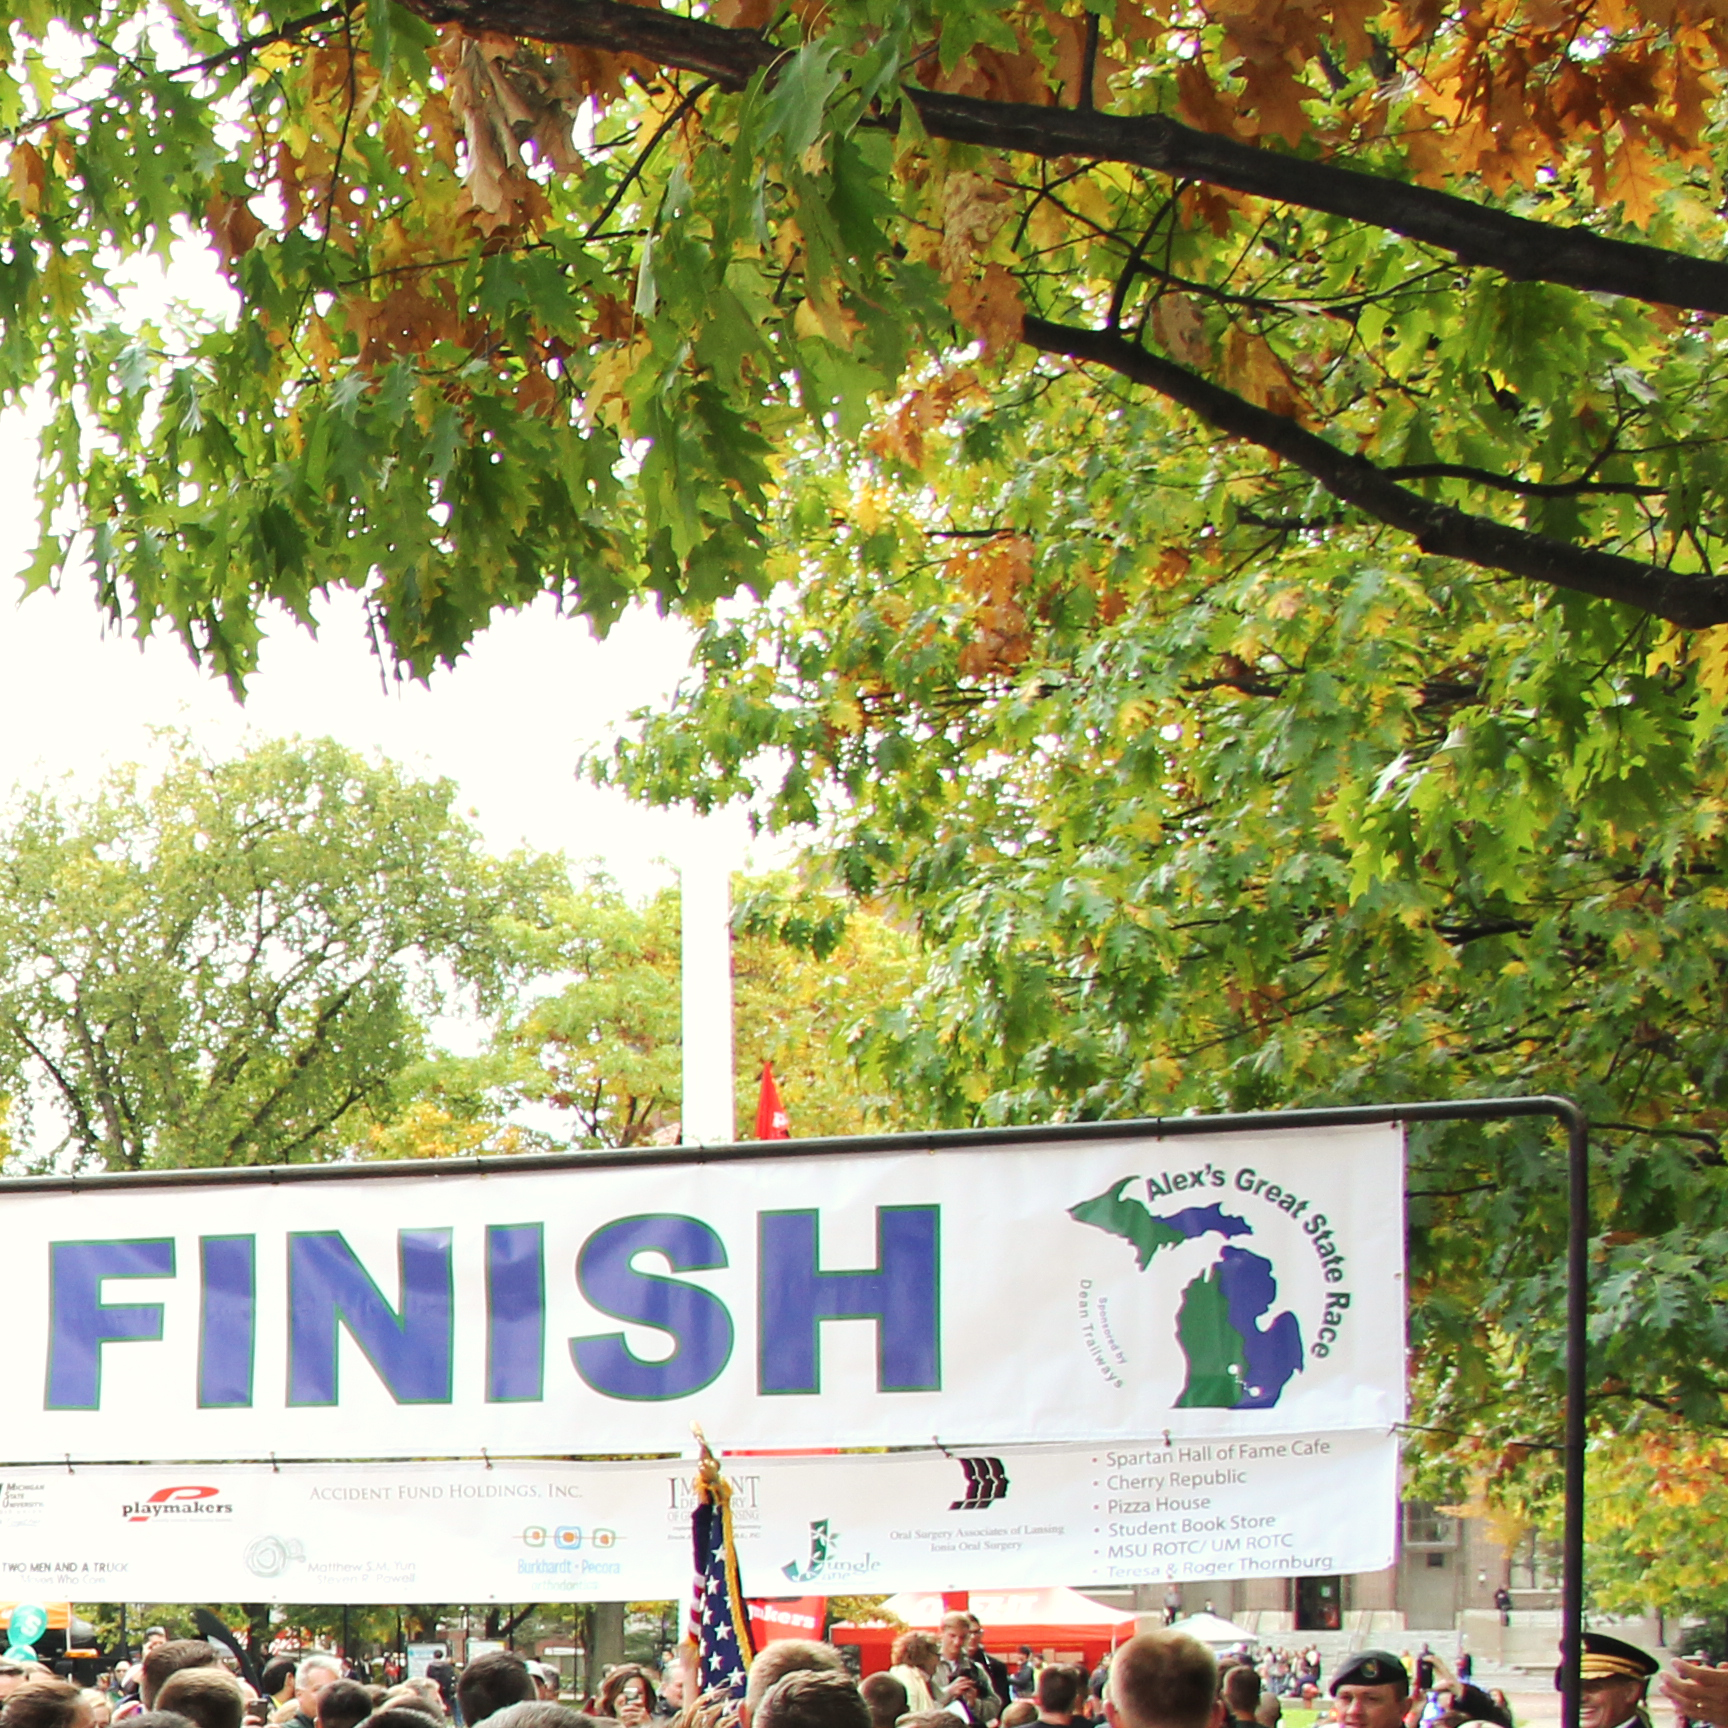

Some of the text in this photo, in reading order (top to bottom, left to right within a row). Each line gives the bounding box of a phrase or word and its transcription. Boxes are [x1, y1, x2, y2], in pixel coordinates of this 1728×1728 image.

[1145, 1163, 1351, 1360] Alex's Great State Race
[44, 1204, 942, 1411] FINISH
[1078, 1279, 1123, 1389] Dean Trailways
[1098, 1297, 1121, 1352] Sponsored
[1106, 1438, 1330, 1469] Spartan Hall of Fame Cafe
[1107, 1469, 1247, 1492] Cherry Republic
[309, 1486, 392, 1501] ACCIDENT
[398, 1485, 444, 1500] FUND
[547, 1483, 584, 1499] INC.
[122, 1501, 233, 1517] playmakers
[1108, 1497, 1211, 1514] Pizza House
[889, 1524, 1064, 1542] Oral Surgery Associates of Lansing
[1108, 1514, 1276, 1537] Student Book Store
[958, 1542, 981, 1551] Oral
[984, 1541, 1023, 1552] Surgery
[1108, 1533, 1293, 1559] MSU ROTC/ UM ROTC
[2, 1562, 128, 1573] TWO MEN AND A TRUCK
[307, 1562, 363, 1573] Matthew
[394, 1561, 416, 1571] Yun
[517, 1558, 621, 1574] Burkhardt Pecora
[1108, 1555, 1333, 1578] Teresa & Roger Thornburg
[376, 1573, 416, 1584] Powell
